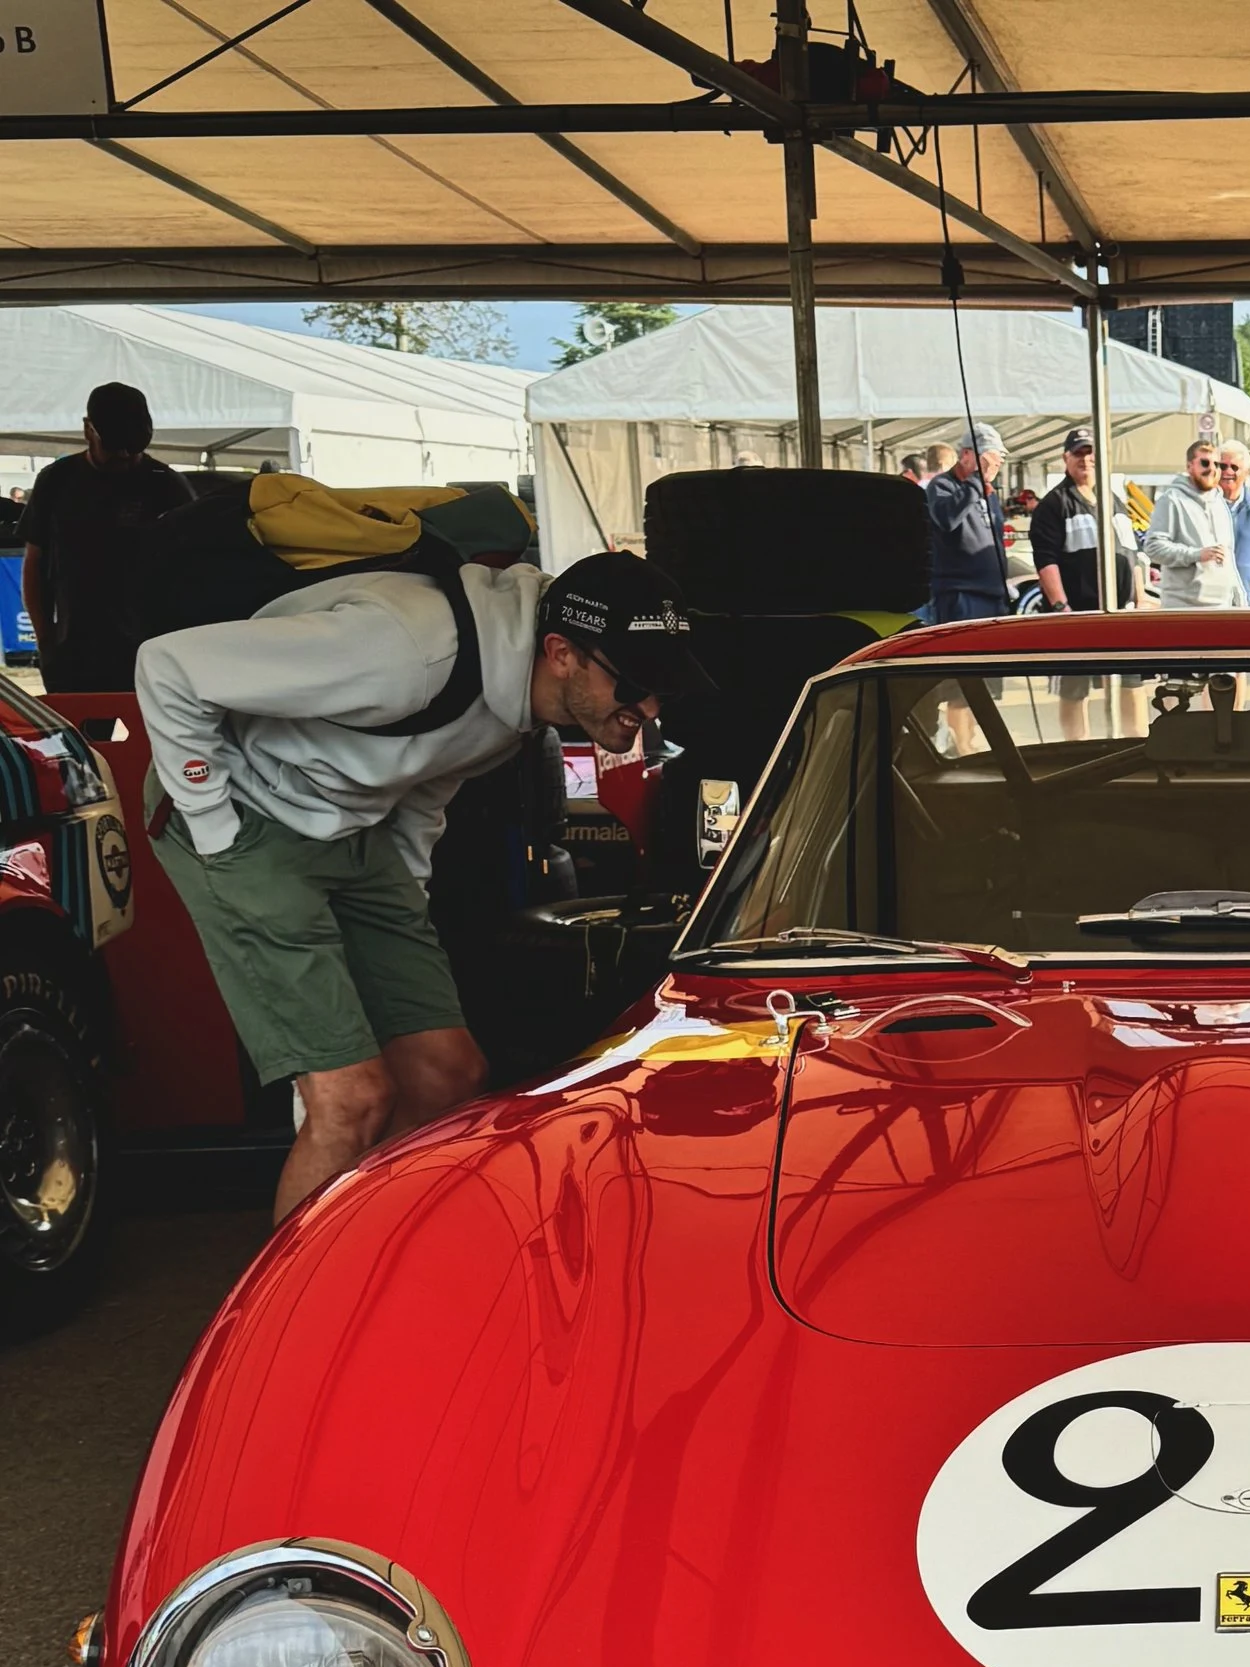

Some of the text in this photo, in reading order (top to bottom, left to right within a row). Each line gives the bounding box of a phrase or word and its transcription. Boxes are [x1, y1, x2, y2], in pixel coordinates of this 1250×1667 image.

[15, 27, 36, 53] B
[561, 605, 574, 617] 70
[575, 610, 607, 628] YEARS
